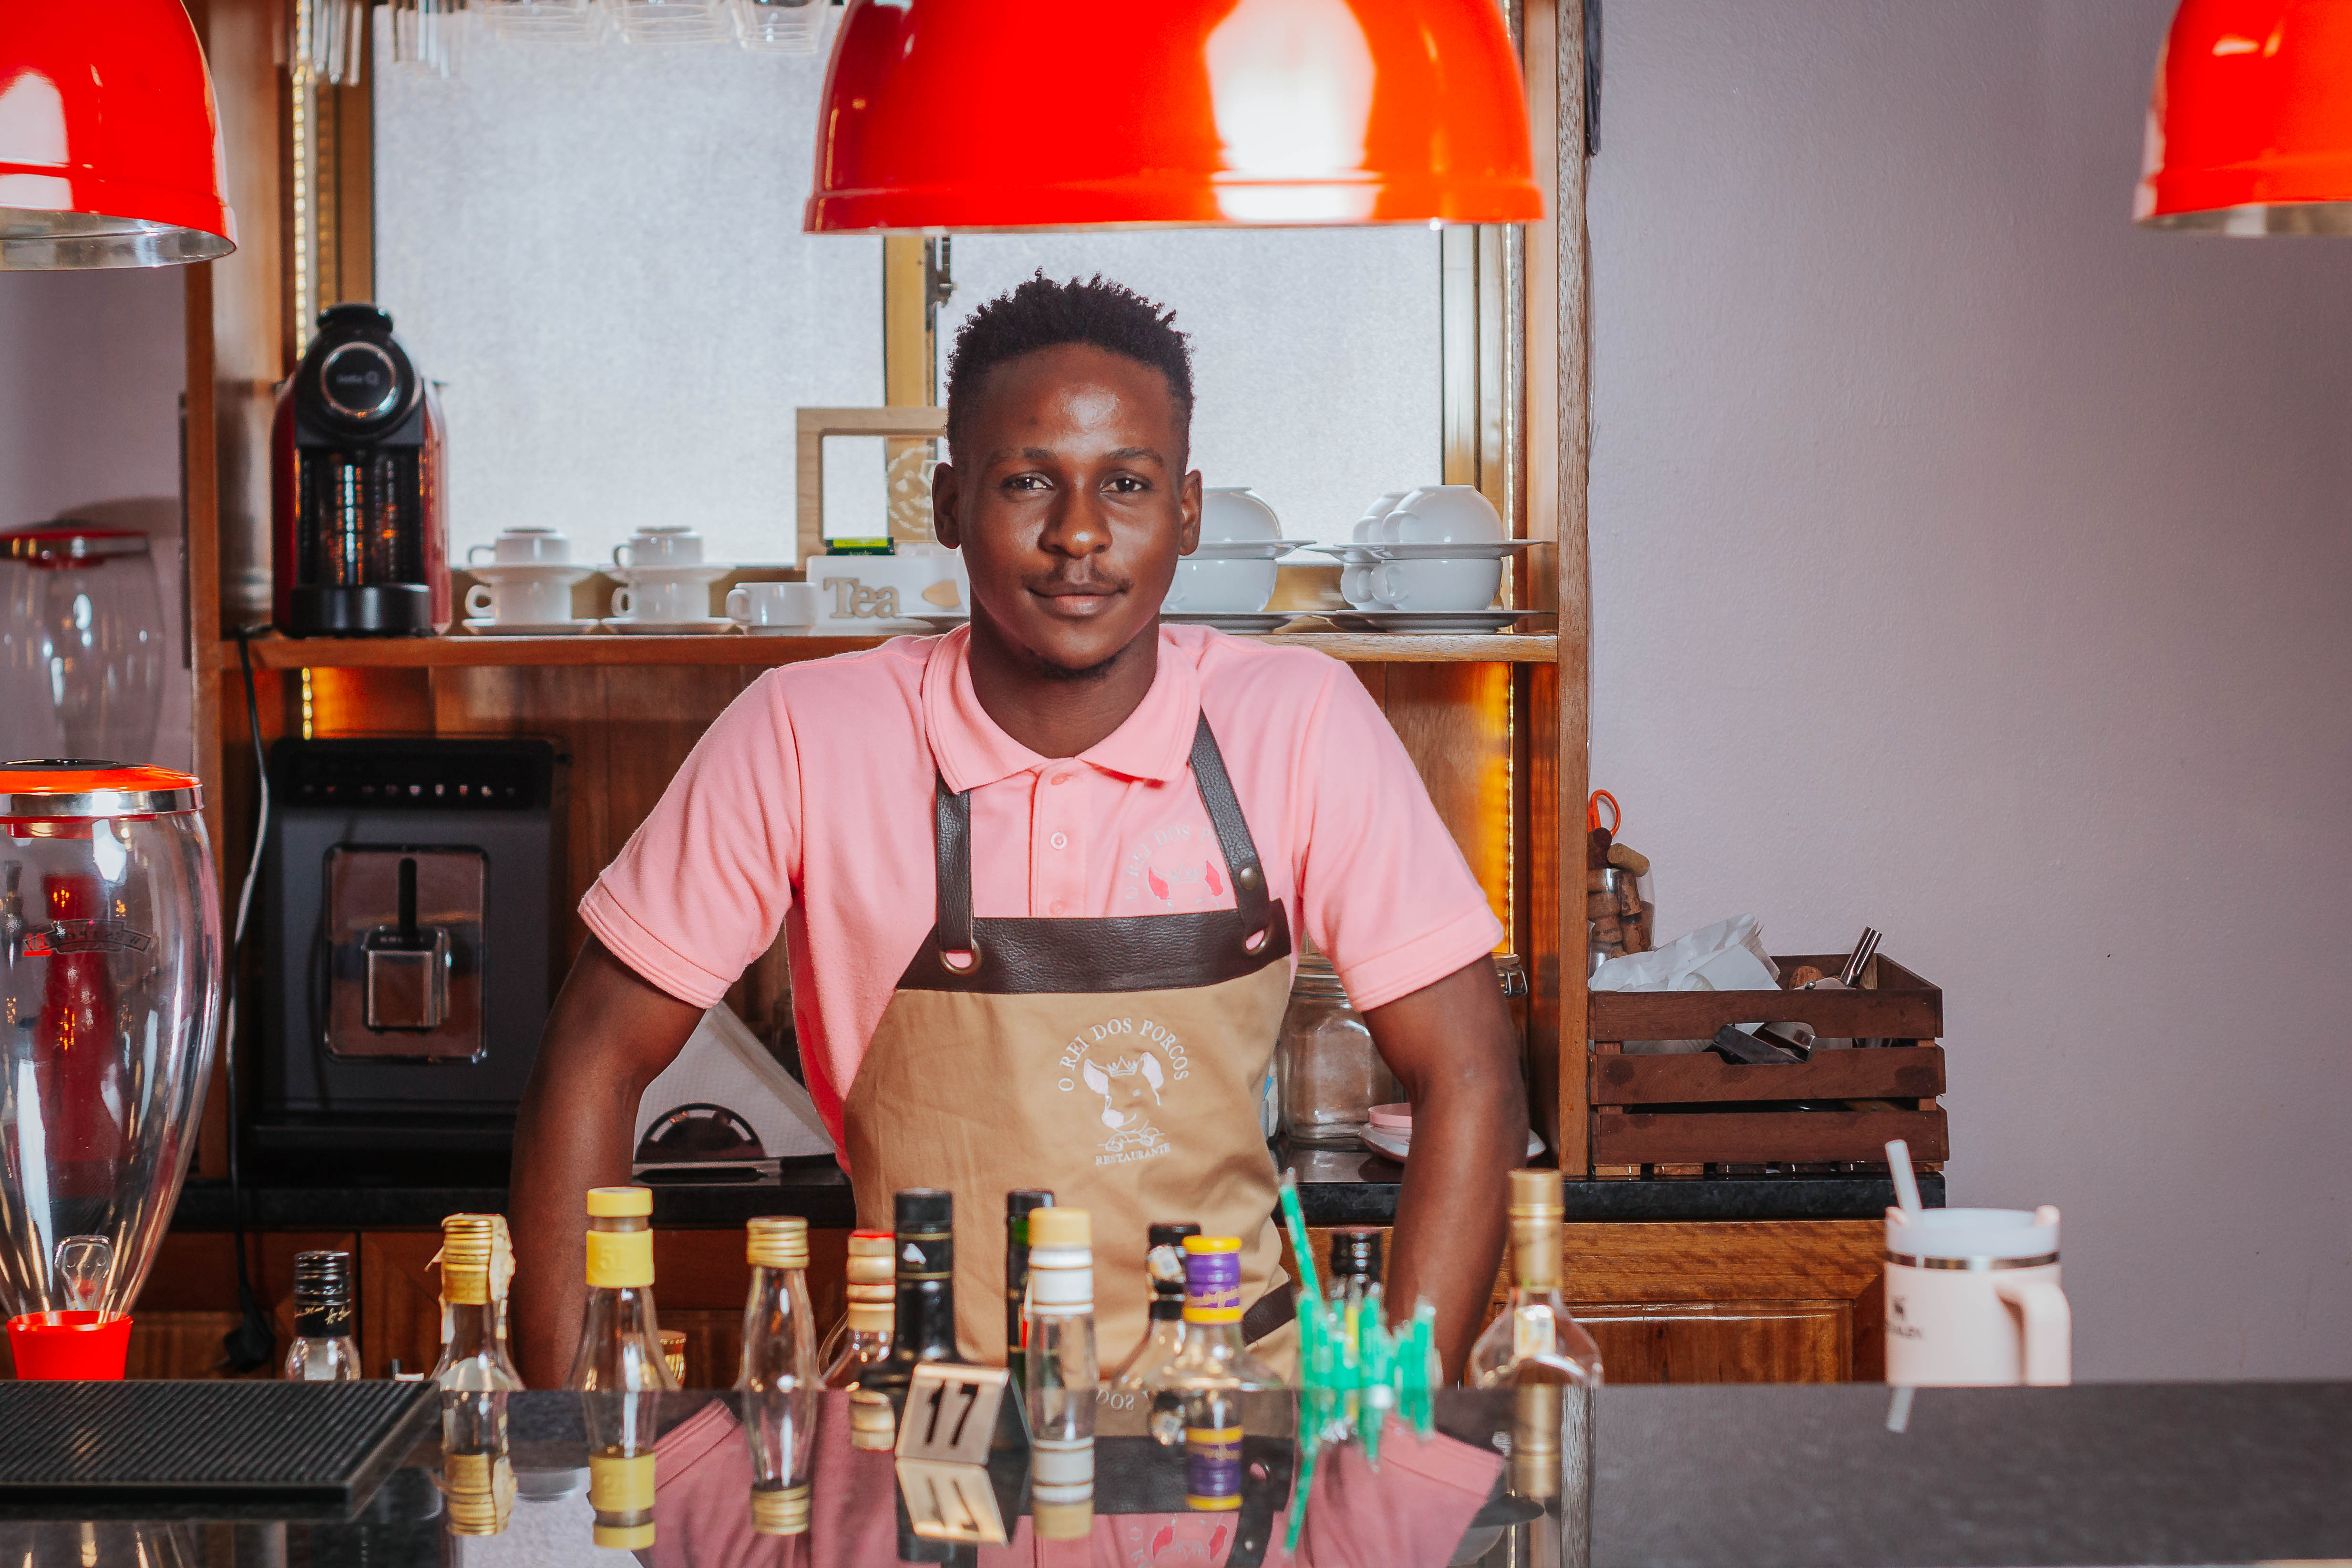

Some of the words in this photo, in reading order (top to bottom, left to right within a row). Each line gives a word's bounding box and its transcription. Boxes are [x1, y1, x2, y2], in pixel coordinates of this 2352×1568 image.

[823, 577, 903, 618] Tea
[1154, 824, 1191, 847] DOS
[1126, 843, 1152, 878] REI
[1125, 886, 1139, 900] O
[1089, 1017, 1132, 1042] DOS
[1059, 1035, 1090, 1071] REI
[1139, 1019, 1190, 1081] PORCOS
[1058, 1077, 1075, 1092] O
[1095, 1142, 1171, 1166] RESTAURANTE
[926, 1379, 979, 1447] 17
